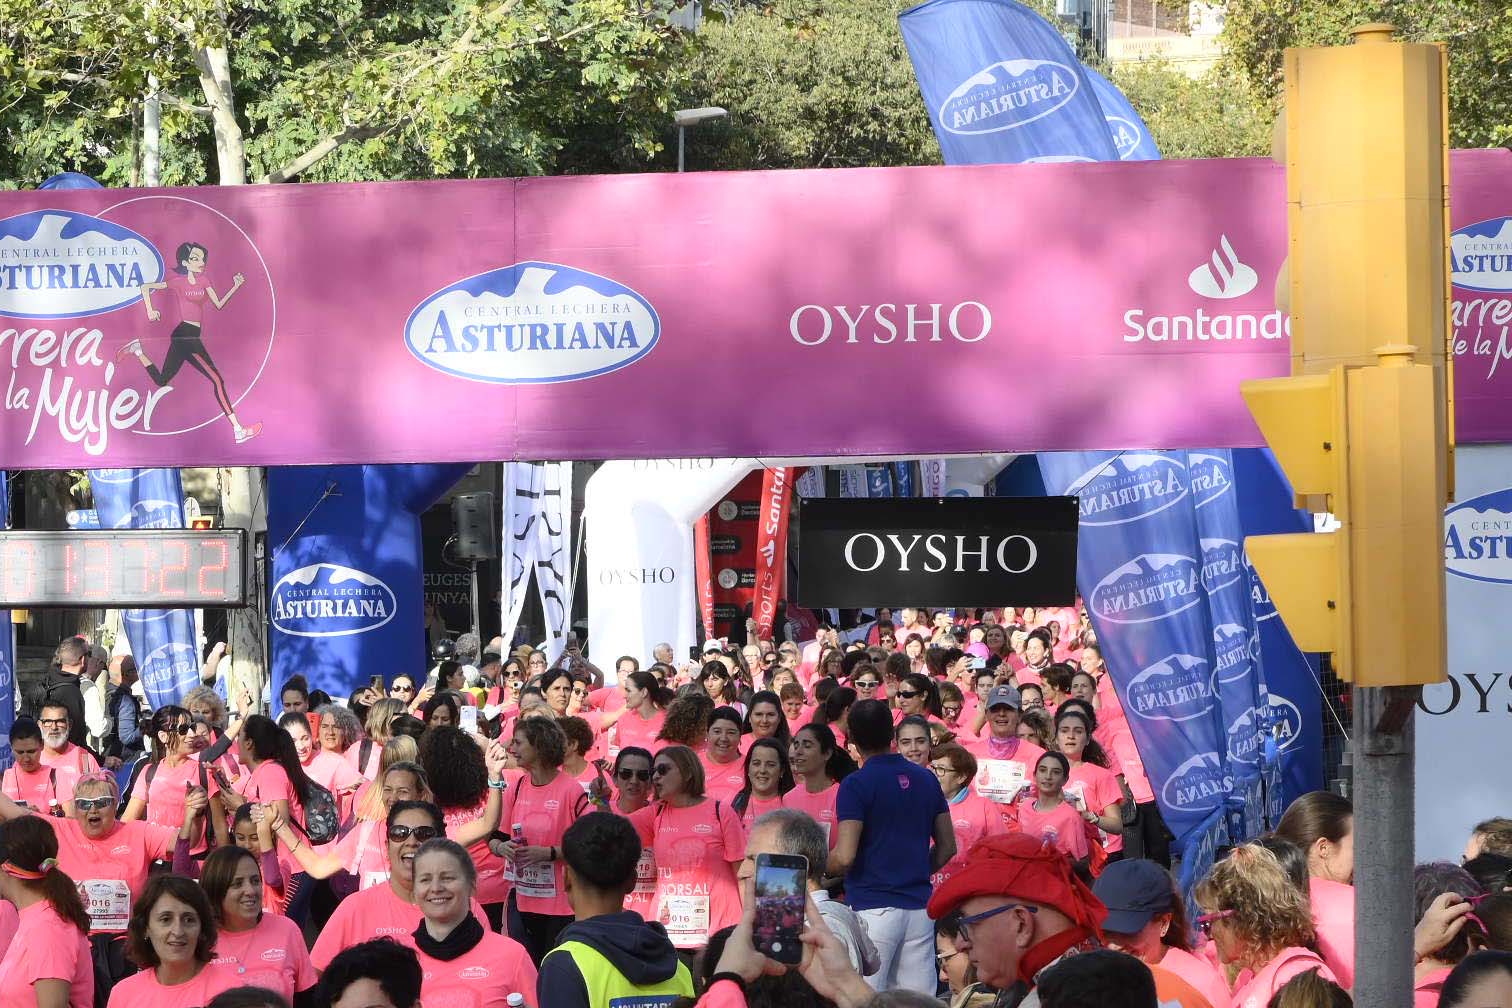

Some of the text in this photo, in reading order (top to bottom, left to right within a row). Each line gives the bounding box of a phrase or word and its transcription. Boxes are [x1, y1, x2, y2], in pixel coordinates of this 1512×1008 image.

[68, 245, 139, 257] LECHERA
[464, 302, 633, 316] CENTRAL LECHERA
[425, 309, 641, 354] ASTURIANA
[789, 301, 993, 346] OYSHO
[5, 372, 30, 410] la
[26, 363, 174, 455] Mujer
[844, 532, 1038, 574] OYSHO
[599, 567, 675, 585] OYSHO
[274, 592, 386, 620] ASTURIANA
[334, 588, 383, 596] LECHERA
